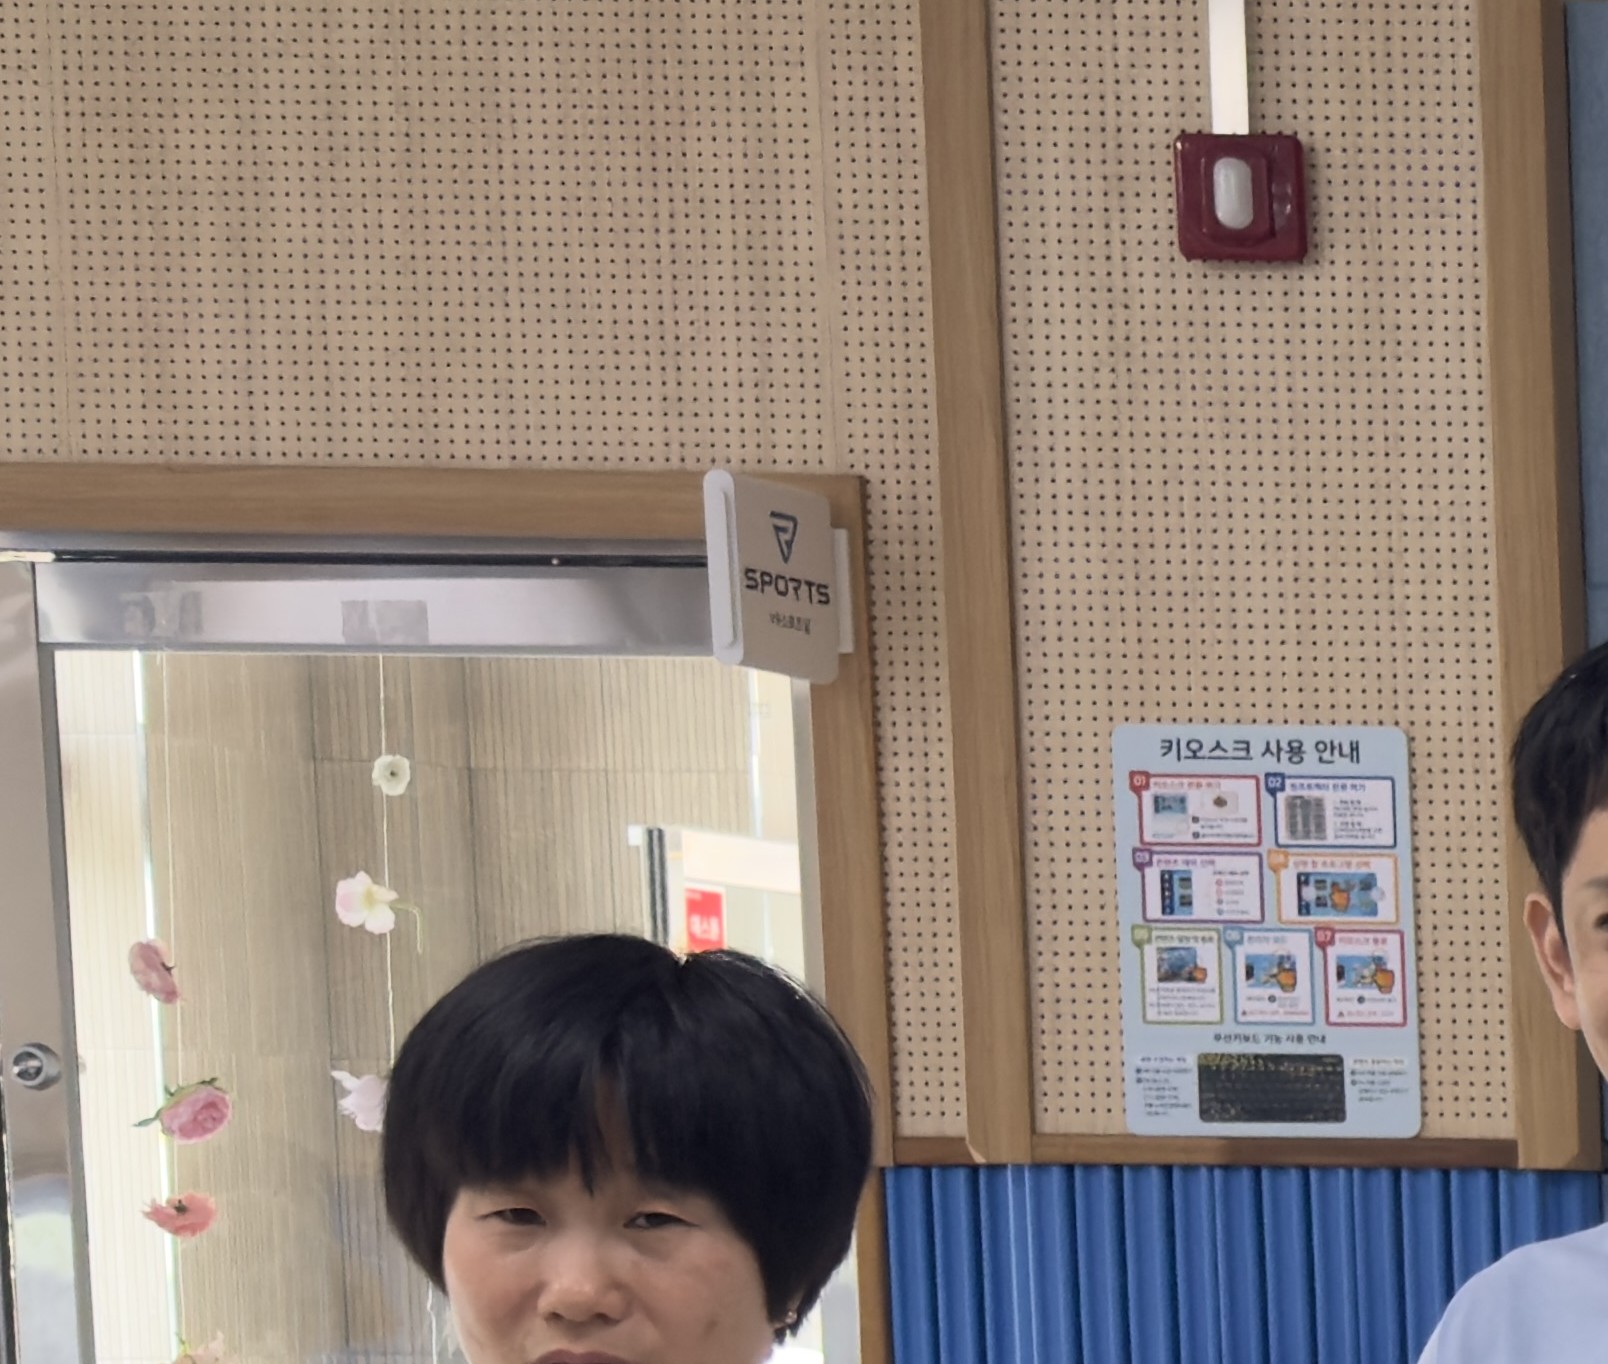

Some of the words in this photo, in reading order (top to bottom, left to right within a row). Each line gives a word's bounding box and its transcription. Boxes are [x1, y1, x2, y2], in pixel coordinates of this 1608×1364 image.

[744, 567, 831, 605] SPORTS
[1160, 737, 1253, 763] 키오스크
[1261, 738, 1307, 764] 사용
[1315, 738, 1361, 765] 안내
